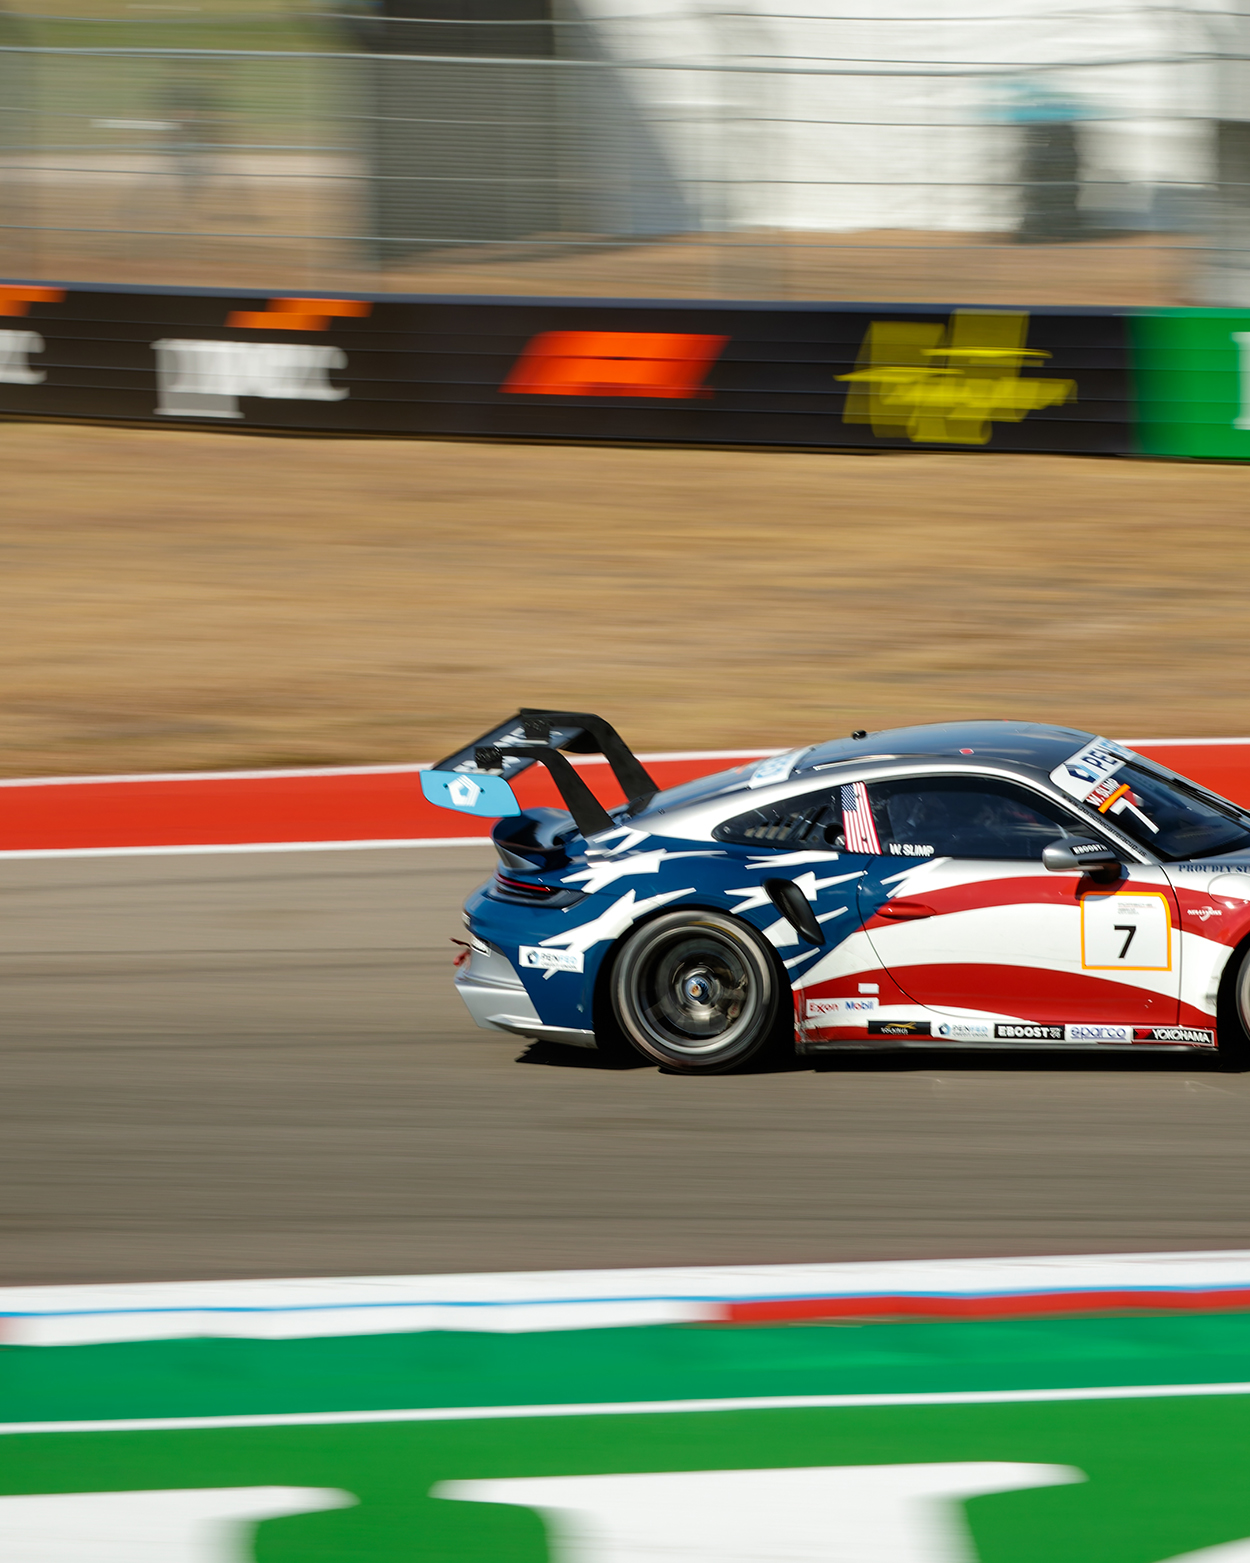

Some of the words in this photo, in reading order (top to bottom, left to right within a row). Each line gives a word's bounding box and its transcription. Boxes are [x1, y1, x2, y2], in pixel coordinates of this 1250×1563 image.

[1109, 796, 1160, 835] 7
[1178, 864, 1233, 873] PROUDLY
[1114, 925, 1137, 959] 7
[809, 1002, 839, 1013] Exxon
[845, 1000, 875, 1011] Mobil
[997, 1026, 1050, 1038] EBOOST
[1153, 1029, 1212, 1043] YOKOHAMA
